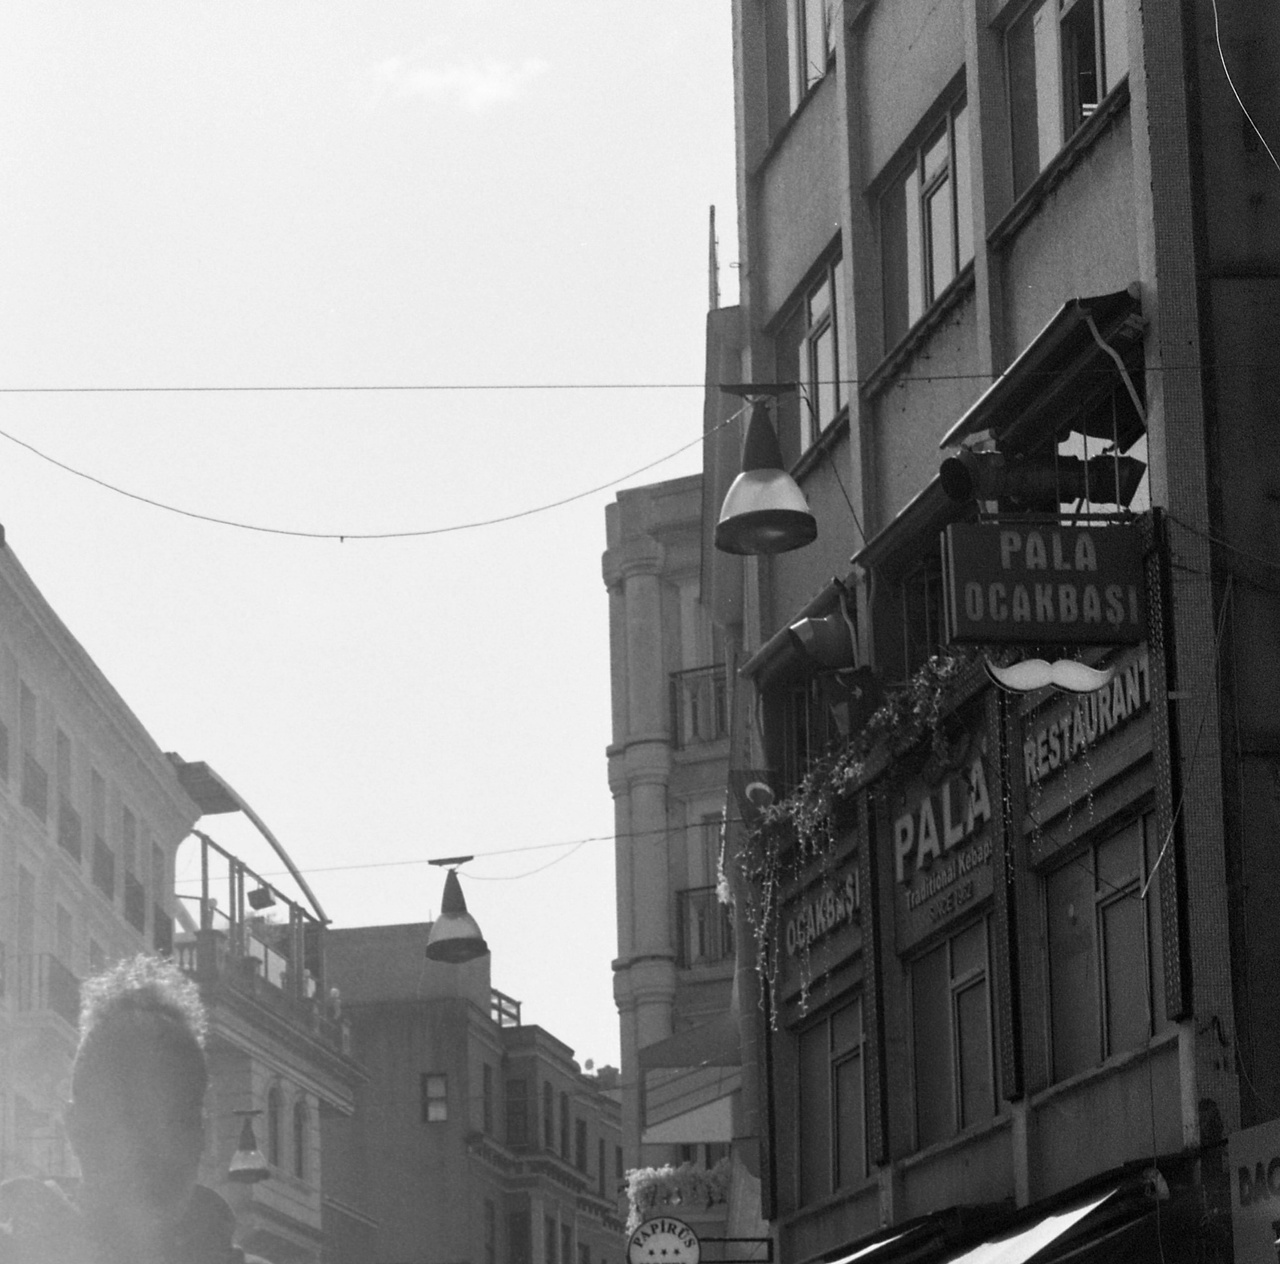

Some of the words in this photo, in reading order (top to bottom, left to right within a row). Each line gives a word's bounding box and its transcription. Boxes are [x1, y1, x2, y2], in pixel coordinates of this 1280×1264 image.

[999, 530, 1098, 571] PALA
[965, 581, 1139, 630] OCAKBAŞI
[1023, 639, 1151, 787] RESTAURANT
[894, 757, 992, 883] PALA
[786, 867, 861, 956] OCAKBAŞI
[905, 860, 956, 910] Traditional
